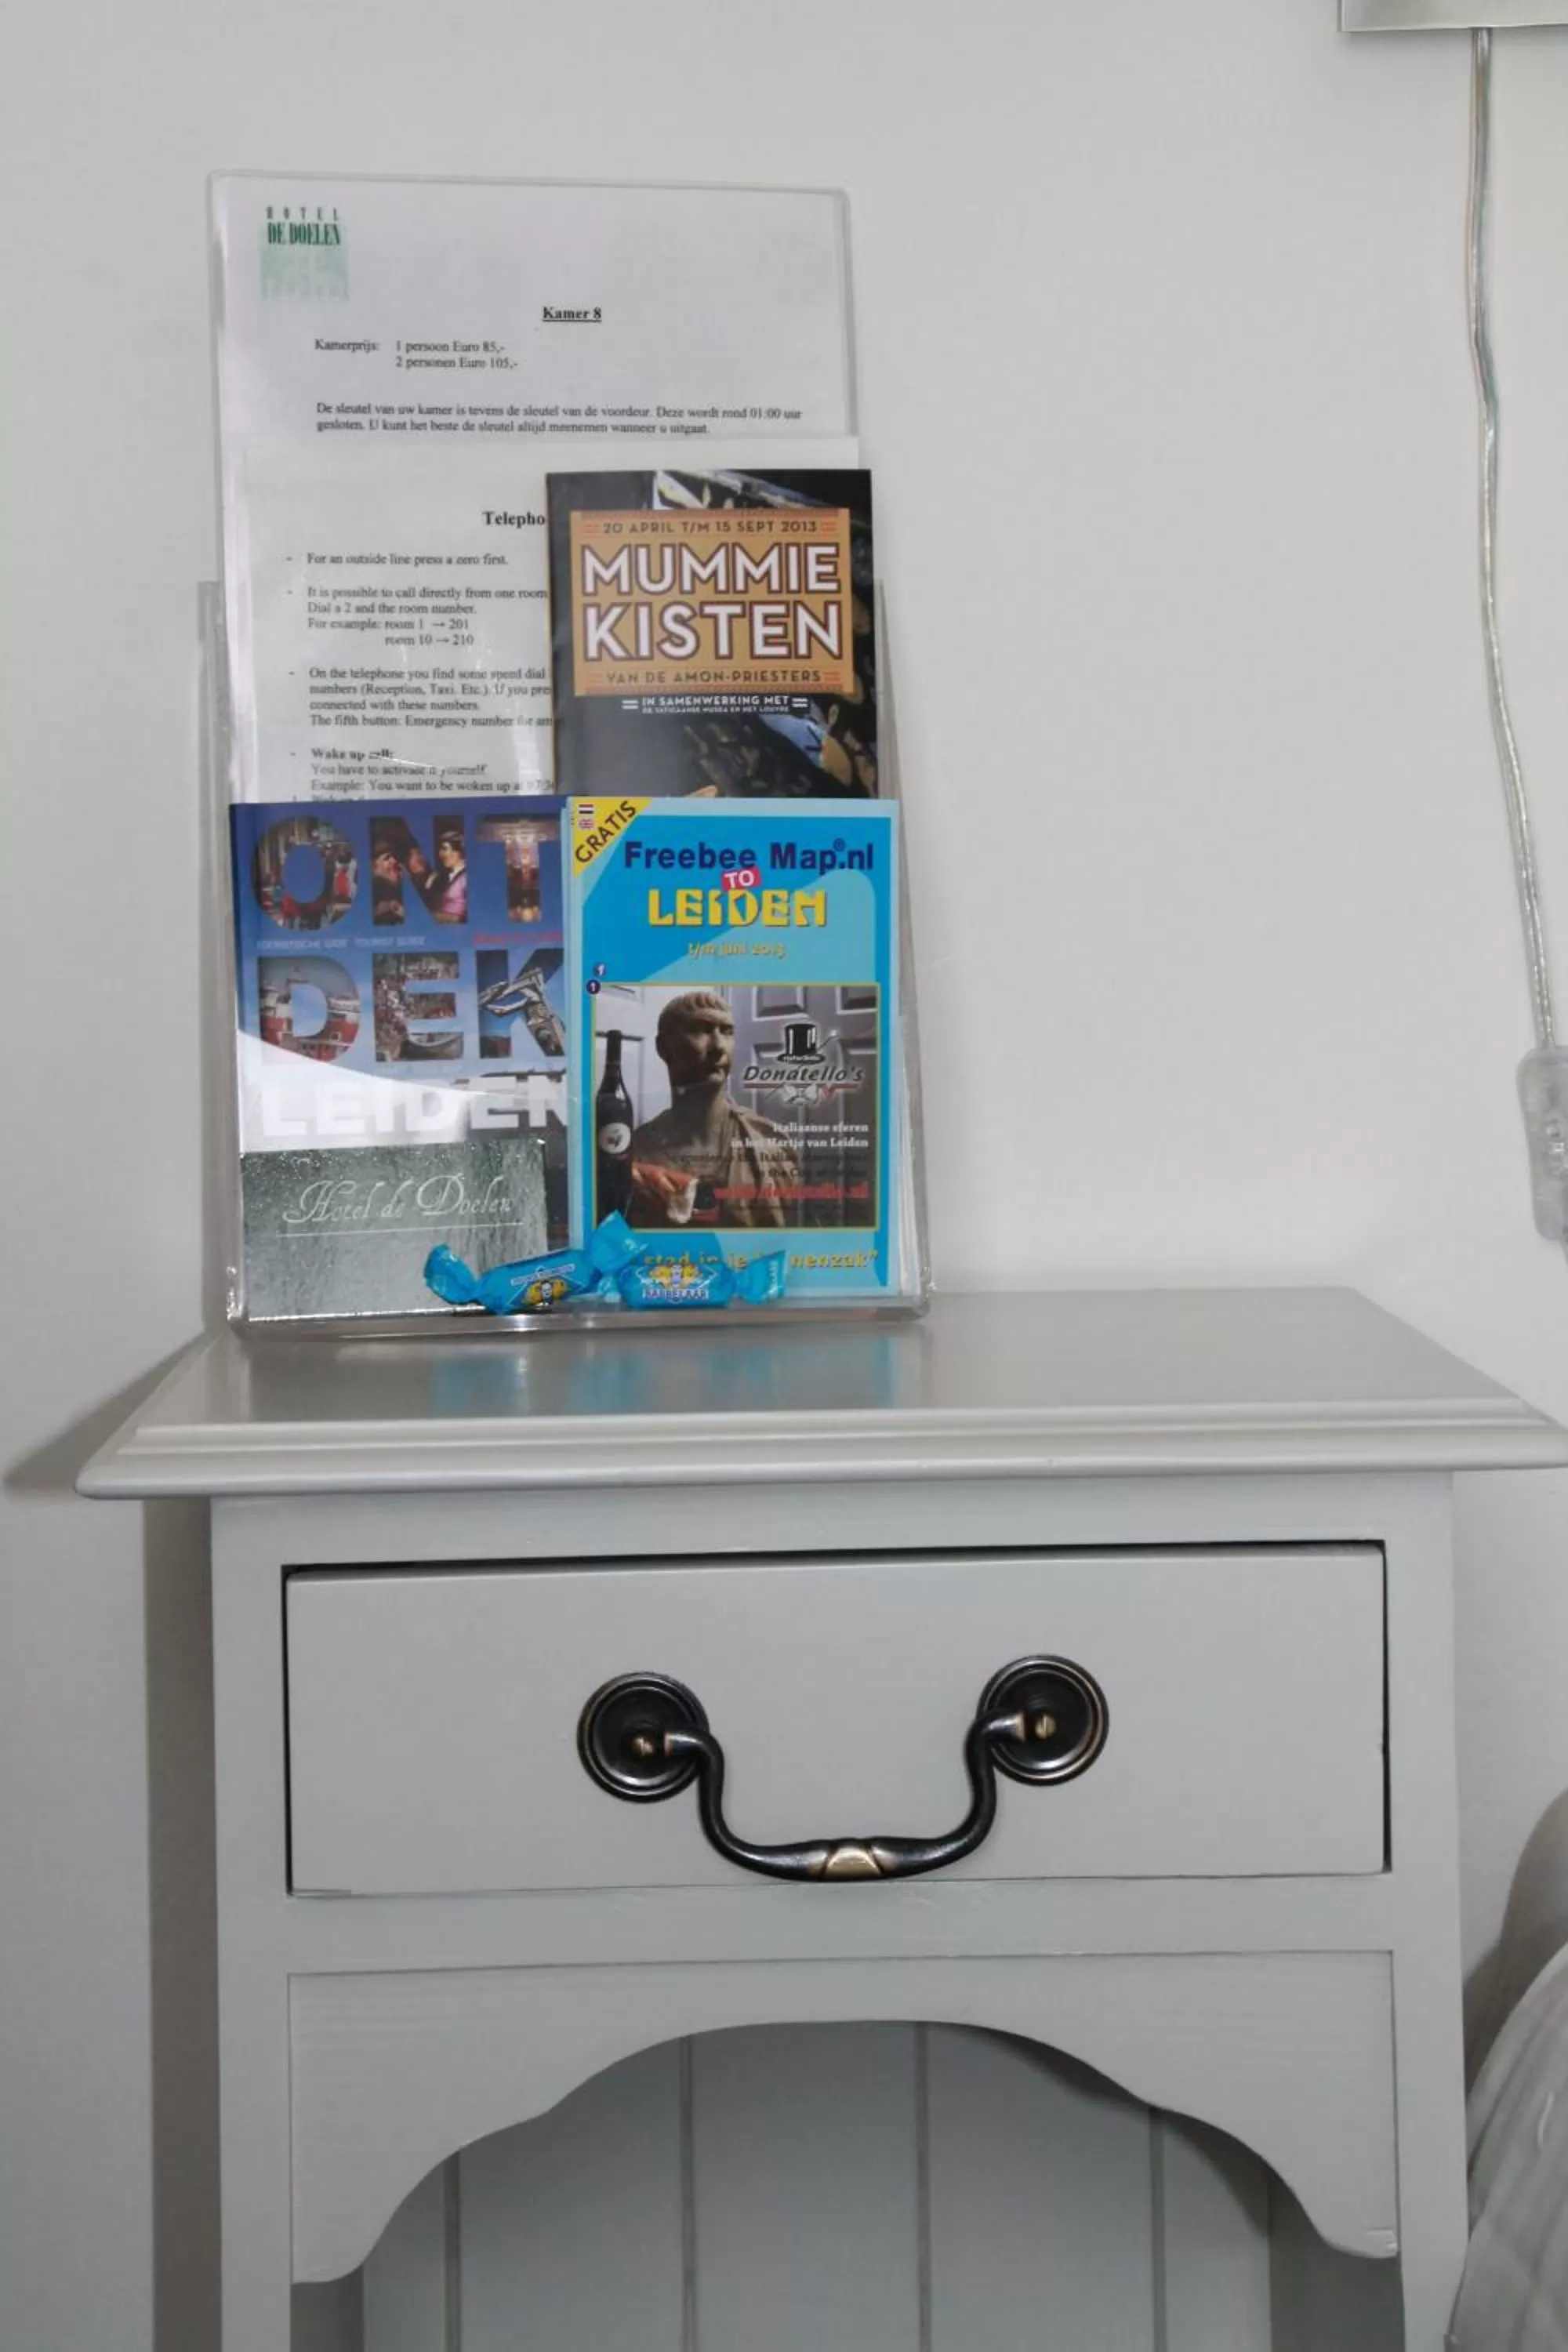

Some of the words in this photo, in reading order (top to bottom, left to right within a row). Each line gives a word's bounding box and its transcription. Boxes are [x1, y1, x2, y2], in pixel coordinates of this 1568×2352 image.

[267, 206, 339, 220] HOTEL
[267, 222, 286, 245] DE
[289, 222, 340, 245] DOELEN
[543, 307, 590, 321] Kamer
[593, 307, 602, 321] 8
[405, 342, 449, 353] persoon
[452, 342, 480, 353] Euro
[396, 356, 403, 367] 2
[405, 358, 456, 369] personen
[459, 358, 486, 368] Euro
[316, 402, 333, 414] De
[336, 402, 372, 415] sleutel
[374, 405, 395, 415] van
[397, 406, 415, 415] uw
[418, 403, 452, 416] kamer
[456, 404, 466, 416] is
[468, 405, 504, 416] tevens
[507, 403, 519, 416] de
[522, 403, 559, 416] sleutel
[562, 407, 581, 416] van
[585, 405, 597, 417] de
[656, 405, 684, 418] Deze
[721, 406, 747, 419] rond
[784, 410, 803, 419] uur
[368, 419, 379, 430] U
[382, 419, 407, 430] kunt
[410, 420, 427, 431] het
[430, 419, 459, 431] beste
[462, 420, 475, 431] de
[478, 420, 514, 432] sleutel
[517, 420, 546, 434] altijd
[603, 522, 623, 535] 20
[629, 521, 673, 534] APRIL
[681, 521, 710, 533] T/M
[716, 521, 731, 532] 15
[737, 521, 775, 532] SEPT
[781, 520, 818, 532] 2013
[307, 554, 327, 564] For
[329, 556, 343, 564] an
[346, 554, 387, 564] outside
[390, 554, 412, 564] line
[414, 555, 443, 567] press
[456, 556, 480, 564] zero
[581, 543, 841, 596] MUMMIE
[307, 589, 317, 598] It
[320, 589, 329, 598] is
[332, 588, 379, 601] possible
[381, 589, 393, 598] to
[395, 588, 416, 598] call
[419, 588, 461, 601] directly
[465, 588, 492, 598] from
[307, 603, 332, 614] Dial
[344, 603, 350, 614] 2
[355, 603, 375, 614] and
[378, 603, 395, 614] the
[398, 605, 428, 614] room
[308, 618, 328, 630] For
[385, 621, 416, 630] room
[448, 619, 470, 630] 201
[583, 601, 843, 661] KISTEN
[385, 637, 416, 645] room
[419, 634, 433, 645] 10
[452, 634, 475, 645] 210
[309, 668, 327, 679] On
[329, 668, 347, 679] the
[350, 667, 405, 682] telephone
[408, 670, 430, 682] you
[432, 667, 455, 679] find
[458, 670, 488, 679] some
[490, 668, 521, 682] speed
[524, 668, 546, 679] dial
[606, 672, 637, 684] VAN
[642, 671, 666, 684] DE
[673, 670, 822, 683] AMON-PRIESTERS
[309, 683, 358, 695] numbers
[507, 686, 528, 698] you
[309, 698, 367, 710] connected
[369, 699, 394, 710] with
[397, 699, 427, 710] these
[642, 696, 655, 706] IN
[659, 695, 760, 706] SAMENWERKING
[764, 695, 789, 705] MET
[310, 714, 332, 726] The
[334, 713, 358, 726] fifth
[405, 715, 467, 728] Emergency
[471, 715, 513, 727] number
[311, 748, 347, 760] Wake
[350, 750, 365, 762] up
[311, 764, 336, 775] You
[338, 764, 364, 775] have
[367, 765, 379, 775] to
[369, 779, 392, 790] You
[395, 780, 423, 790] want
[426, 780, 437, 790] to
[440, 779, 453, 790] be
[457, 779, 493, 791] woken
[495, 782, 510, 794] up
[575, 800, 637, 863] GRATIS
[624, 840, 757, 870] Freebee
[251, 813, 563, 931] ONT
[724, 869, 756, 889] TO
[257, 948, 565, 1065] DEK
[742, 1065, 866, 1082] Donatello's
[260, 1071, 568, 1137] LEIDEN
[831, 1121, 869, 1133] sferen
[806, 1140, 828, 1149] van
[830, 1137, 869, 1149] Leiden
[416, 1173, 512, 1215] Doelen
